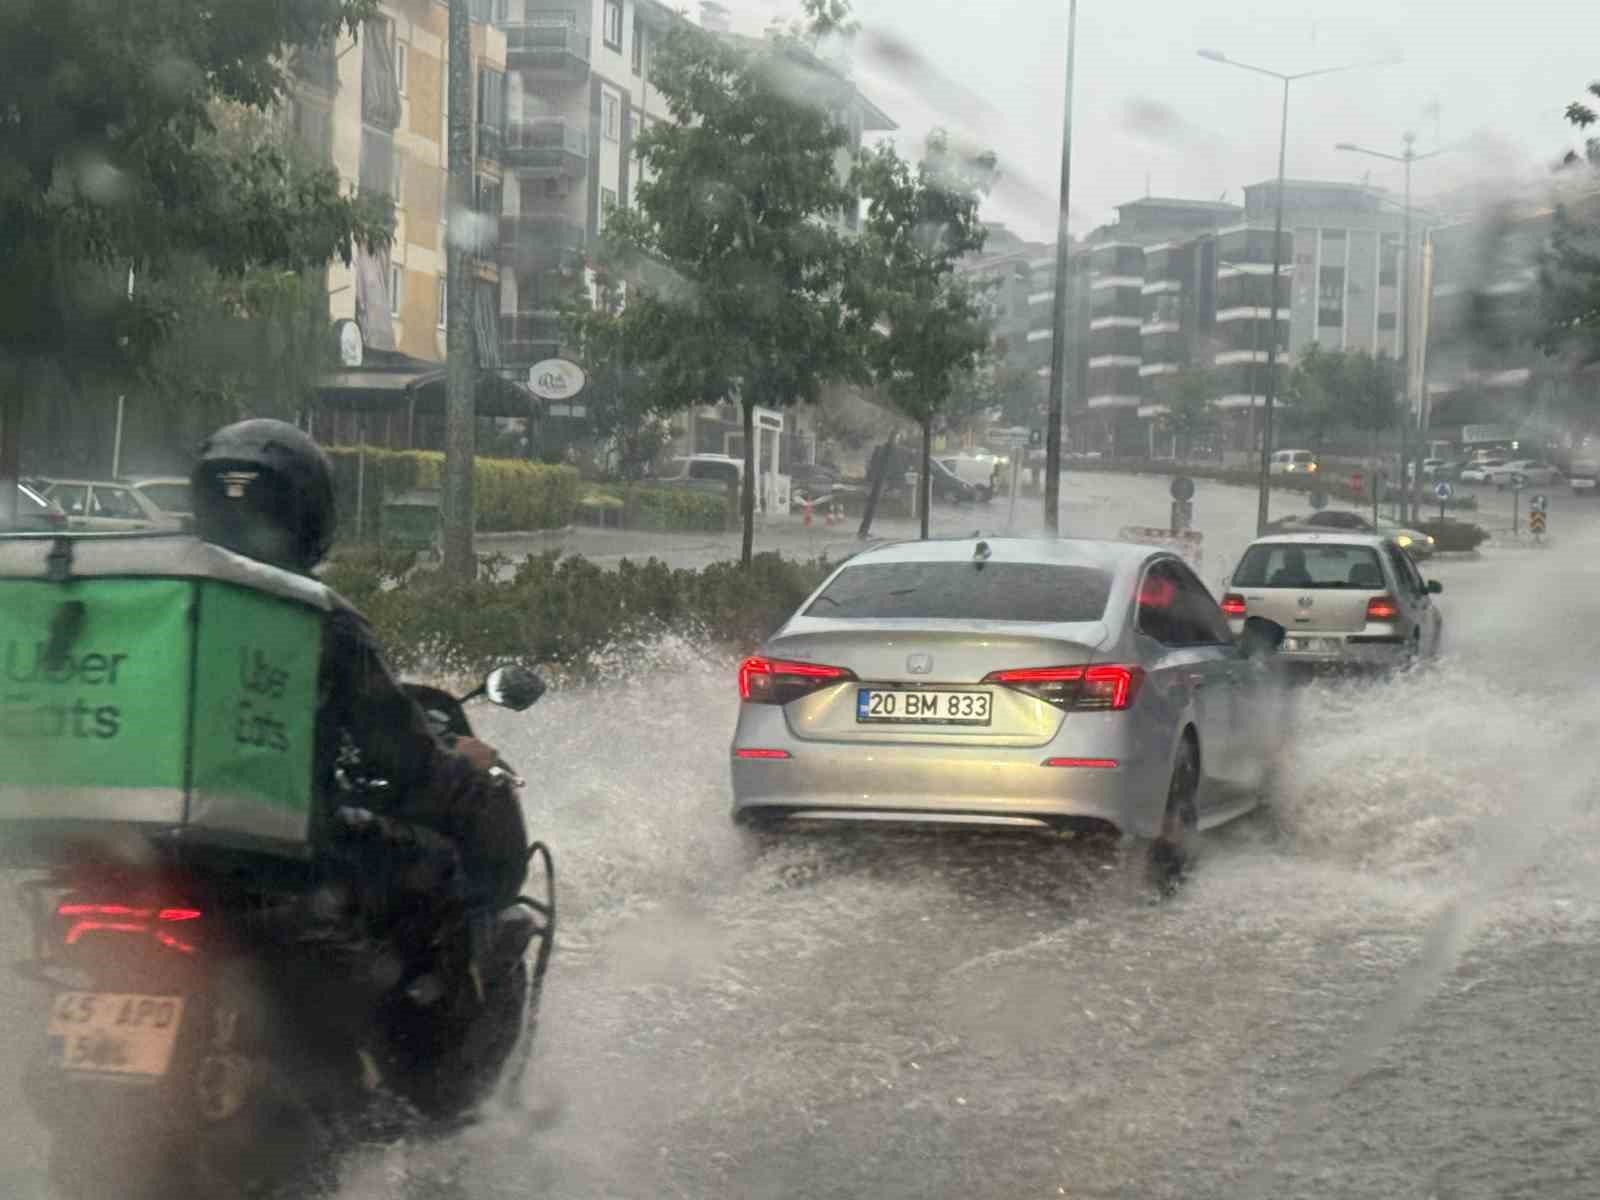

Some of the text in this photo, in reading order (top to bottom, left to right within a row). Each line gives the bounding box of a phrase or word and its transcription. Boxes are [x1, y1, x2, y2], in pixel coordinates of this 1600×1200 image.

[870, 693, 988, 717] 20 BM 833
